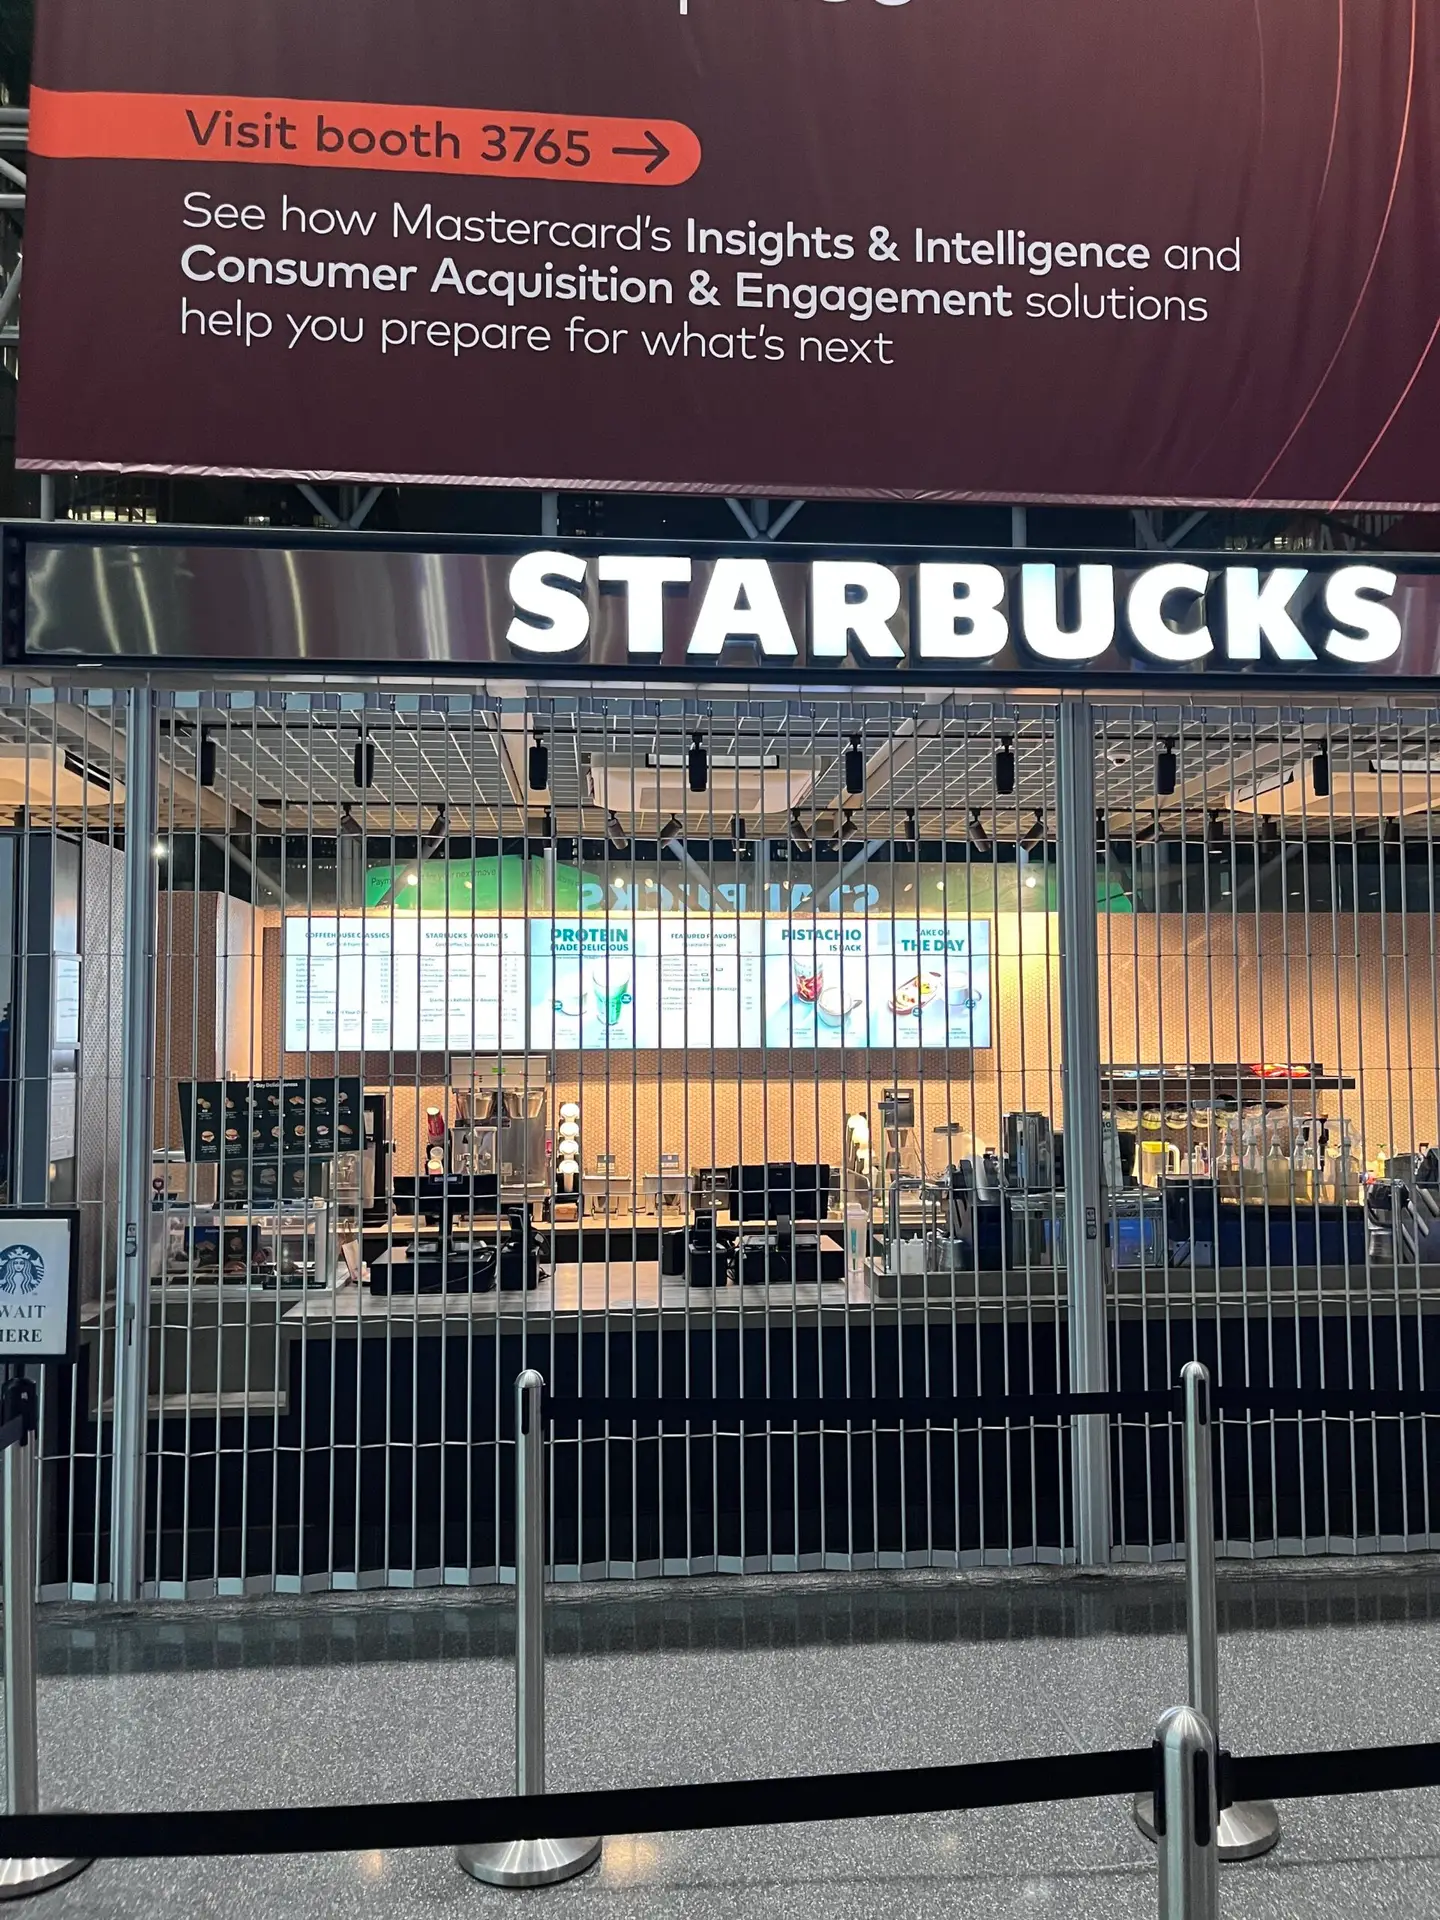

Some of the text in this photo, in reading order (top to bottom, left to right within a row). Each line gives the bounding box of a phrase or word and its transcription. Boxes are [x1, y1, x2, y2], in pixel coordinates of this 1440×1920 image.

[185, 109, 591, 168] Visit booth 3765
[182, 191, 1240, 276] See how Mastercard's Insights & Intelligence and
[181, 244, 1208, 322] Consumer Acquisition & Engagement solutions
[181, 296, 894, 365] help you prepare for what's next
[505, 551, 1402, 663] STARBUCKS
[550, 928, 629, 943] PROTEIN
[580, 943, 629, 952] DELICOUS
[781, 929, 862, 941] PISTACHIO
[829, 944, 862, 952] IS ACK
[901, 939, 965, 952] THE DAY
